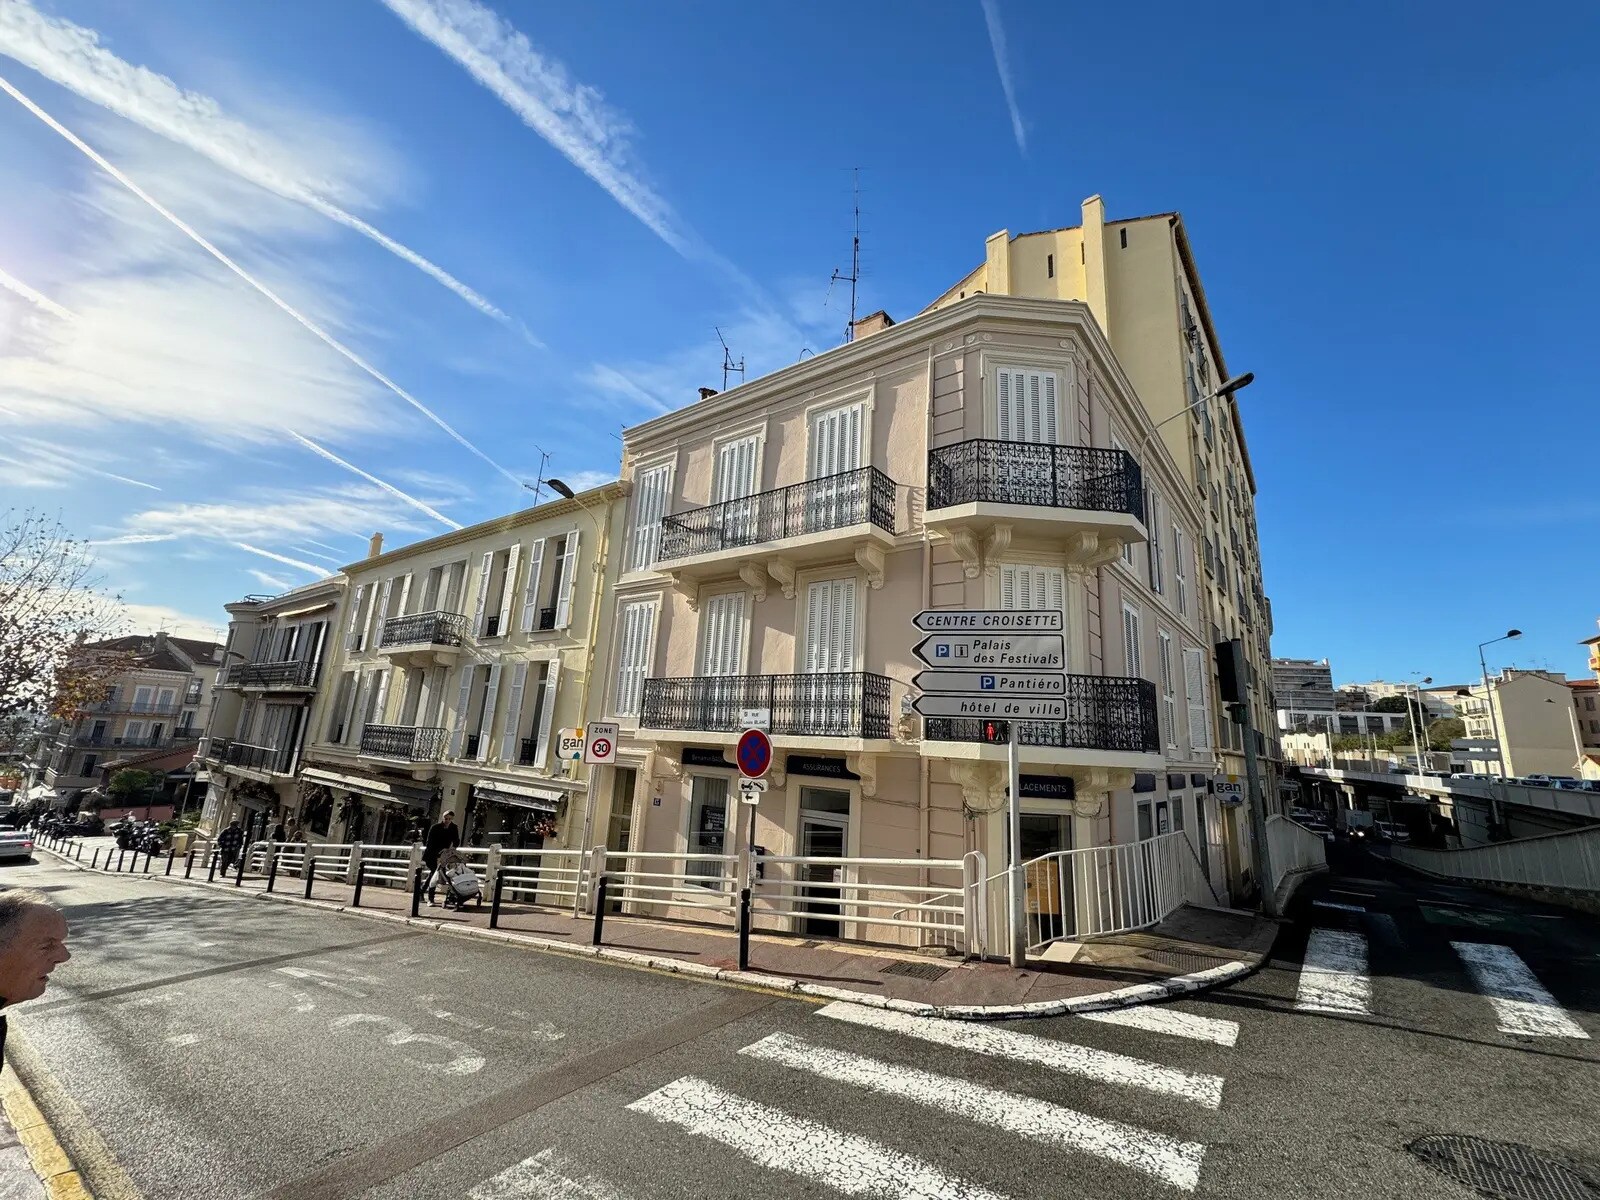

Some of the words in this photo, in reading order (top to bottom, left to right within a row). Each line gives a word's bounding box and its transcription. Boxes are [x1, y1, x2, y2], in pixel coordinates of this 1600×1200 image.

[926, 615, 976, 626] CENTRE
[983, 615, 1058, 626] CROISETTE
[972, 639, 1011, 650] Palais
[973, 653, 995, 664] des
[1000, 653, 1059, 664] Festivals
[1000, 677, 1060, 689] Pantiéro
[960, 702, 996, 713] hôtel
[1004, 703, 1020, 713] de
[1029, 704, 1061, 715] ville
[562, 738, 584, 750] gan
[596, 743, 608, 753] 30
[802, 763, 841, 773] ASSURANCES
[1019, 783, 1067, 793] LACEMENTS
[1216, 782, 1242, 793] gan
